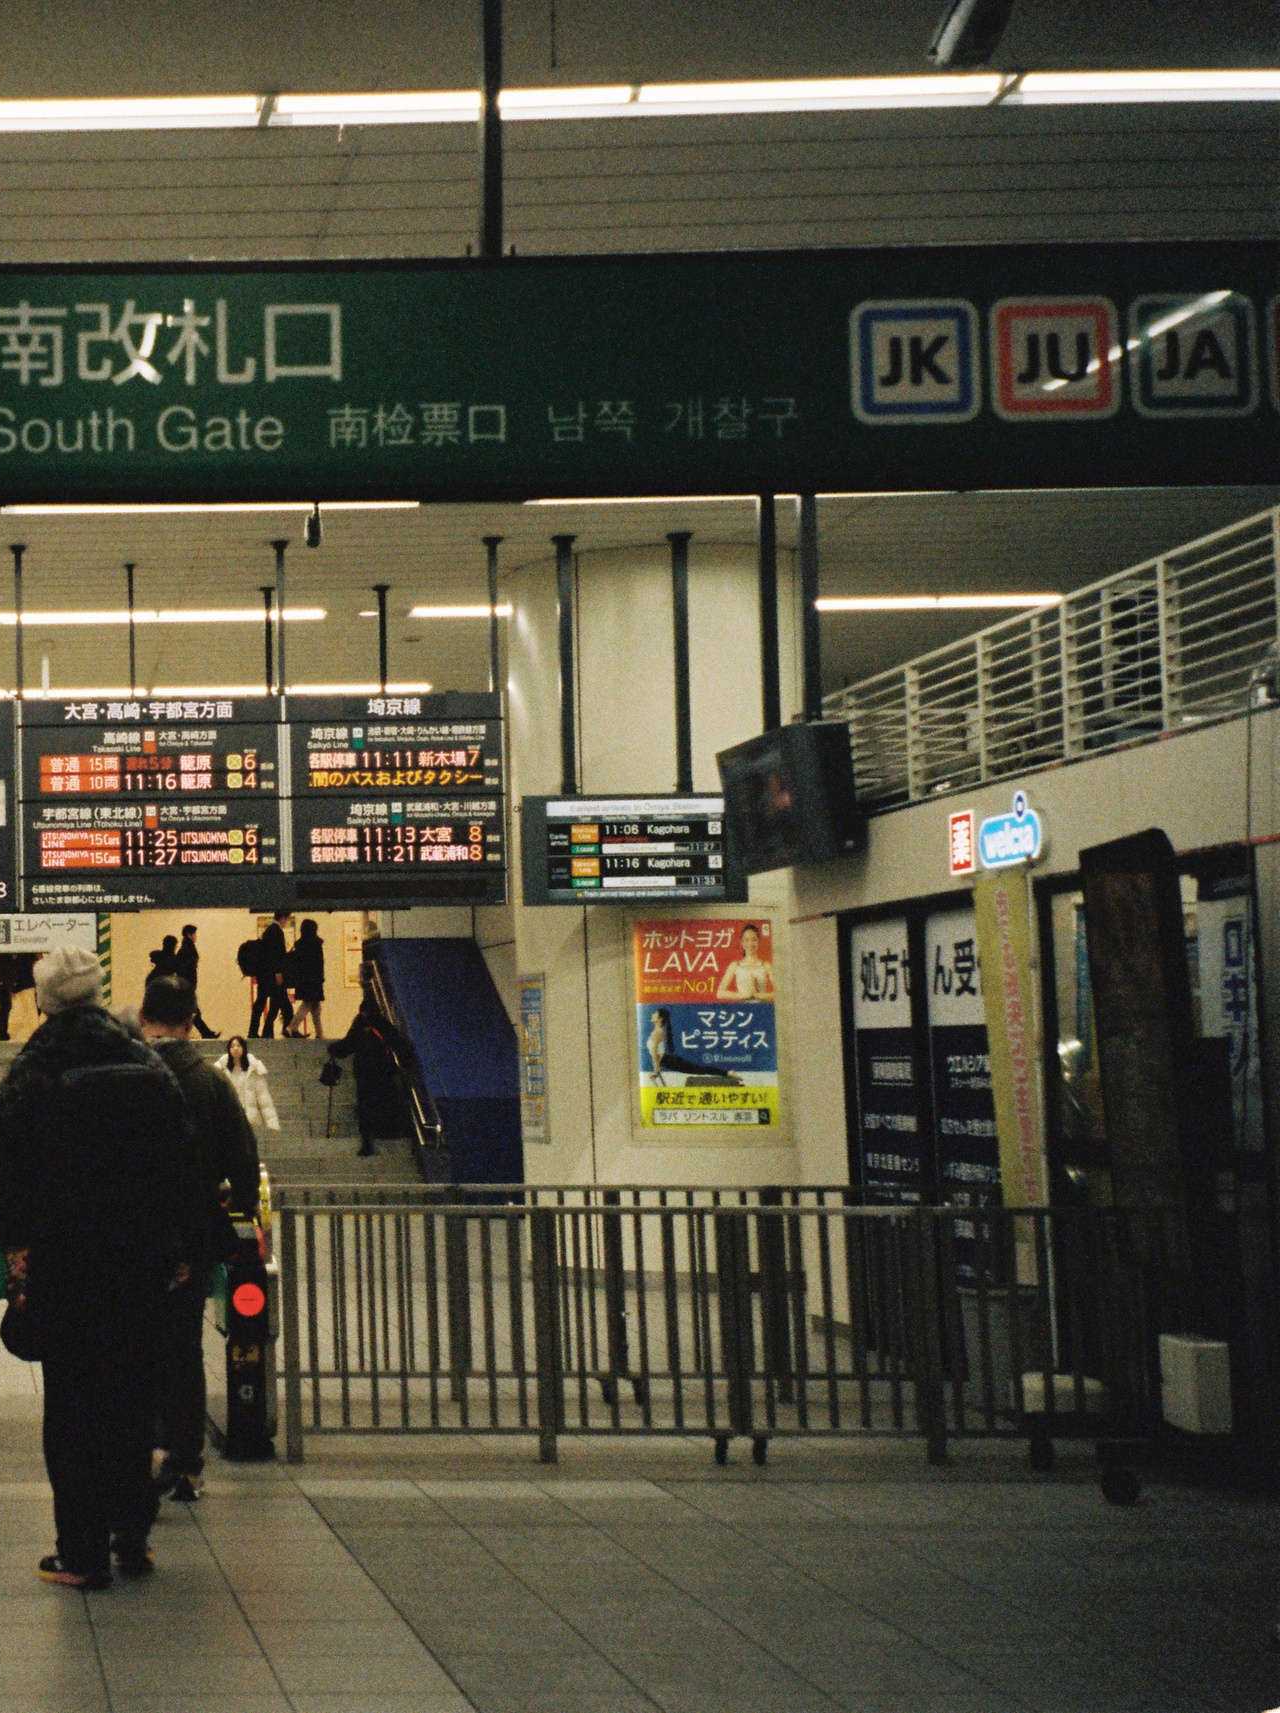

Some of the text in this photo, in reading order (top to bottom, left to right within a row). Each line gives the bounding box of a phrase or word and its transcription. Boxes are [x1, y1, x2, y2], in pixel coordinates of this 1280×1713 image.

[879, 336, 952, 388] JK
[1017, 331, 1090, 385] JU
[1157, 328, 1230, 382] JA
[158, 406, 284, 453] Gate
[327, 402, 507, 448] 南检票口
[547, 400, 802, 442] 남쪽 개찰구
[64, 702, 232, 720] 大宮・高崎・宇都宮方面
[367, 698, 421, 716] 埼京線
[104, 732, 140, 744] 高崎線
[311, 727, 348, 740] 埼京線
[50, 757, 80, 772] 普通
[89, 757, 118, 771] 15両
[243, 754, 255, 770] 6
[362, 751, 413, 767] 11:11
[418, 751, 466, 767] 新木場
[468, 750, 480, 766] 7
[50, 775, 80, 791] 普通
[89, 775, 118, 790] 10両
[125, 774, 177, 791] 11:16
[243, 773, 257, 789] 4
[309, 770, 483, 787] 間のバスおよびタクシー
[350, 803, 388, 816] 埼京線
[125, 830, 177, 846] 11:25
[181, 832, 228, 845] UTSUNOMIYA
[245, 829, 257, 846] 6
[364, 827, 416, 844] 11:13
[420, 827, 452, 843] 大宮
[469, 826, 482, 842] 8
[605, 824, 639, 835] 11:06
[647, 824, 690, 836] Kagohara
[42, 840, 65, 848] LINE
[951, 818, 972, 866] 薬
[125, 849, 177, 866] 11:27
[181, 850, 229, 864] UTSUNOMIYA
[245, 848, 258, 864] 4
[364, 845, 415, 862] 11:21
[420, 845, 468, 861] 武蔵浦和
[469, 845, 482, 861] 8
[42, 859, 65, 867] LINE
[606, 858, 640, 869] 11:16
[648, 857, 691, 869] Kagohara
[13, 919, 91, 931] エレベーター
[643, 929, 735, 949] ホットヨガ
[643, 952, 719, 973] LAVA
[697, 1011, 753, 1026] マシン
[681, 1030, 768, 1049] ピラティス
